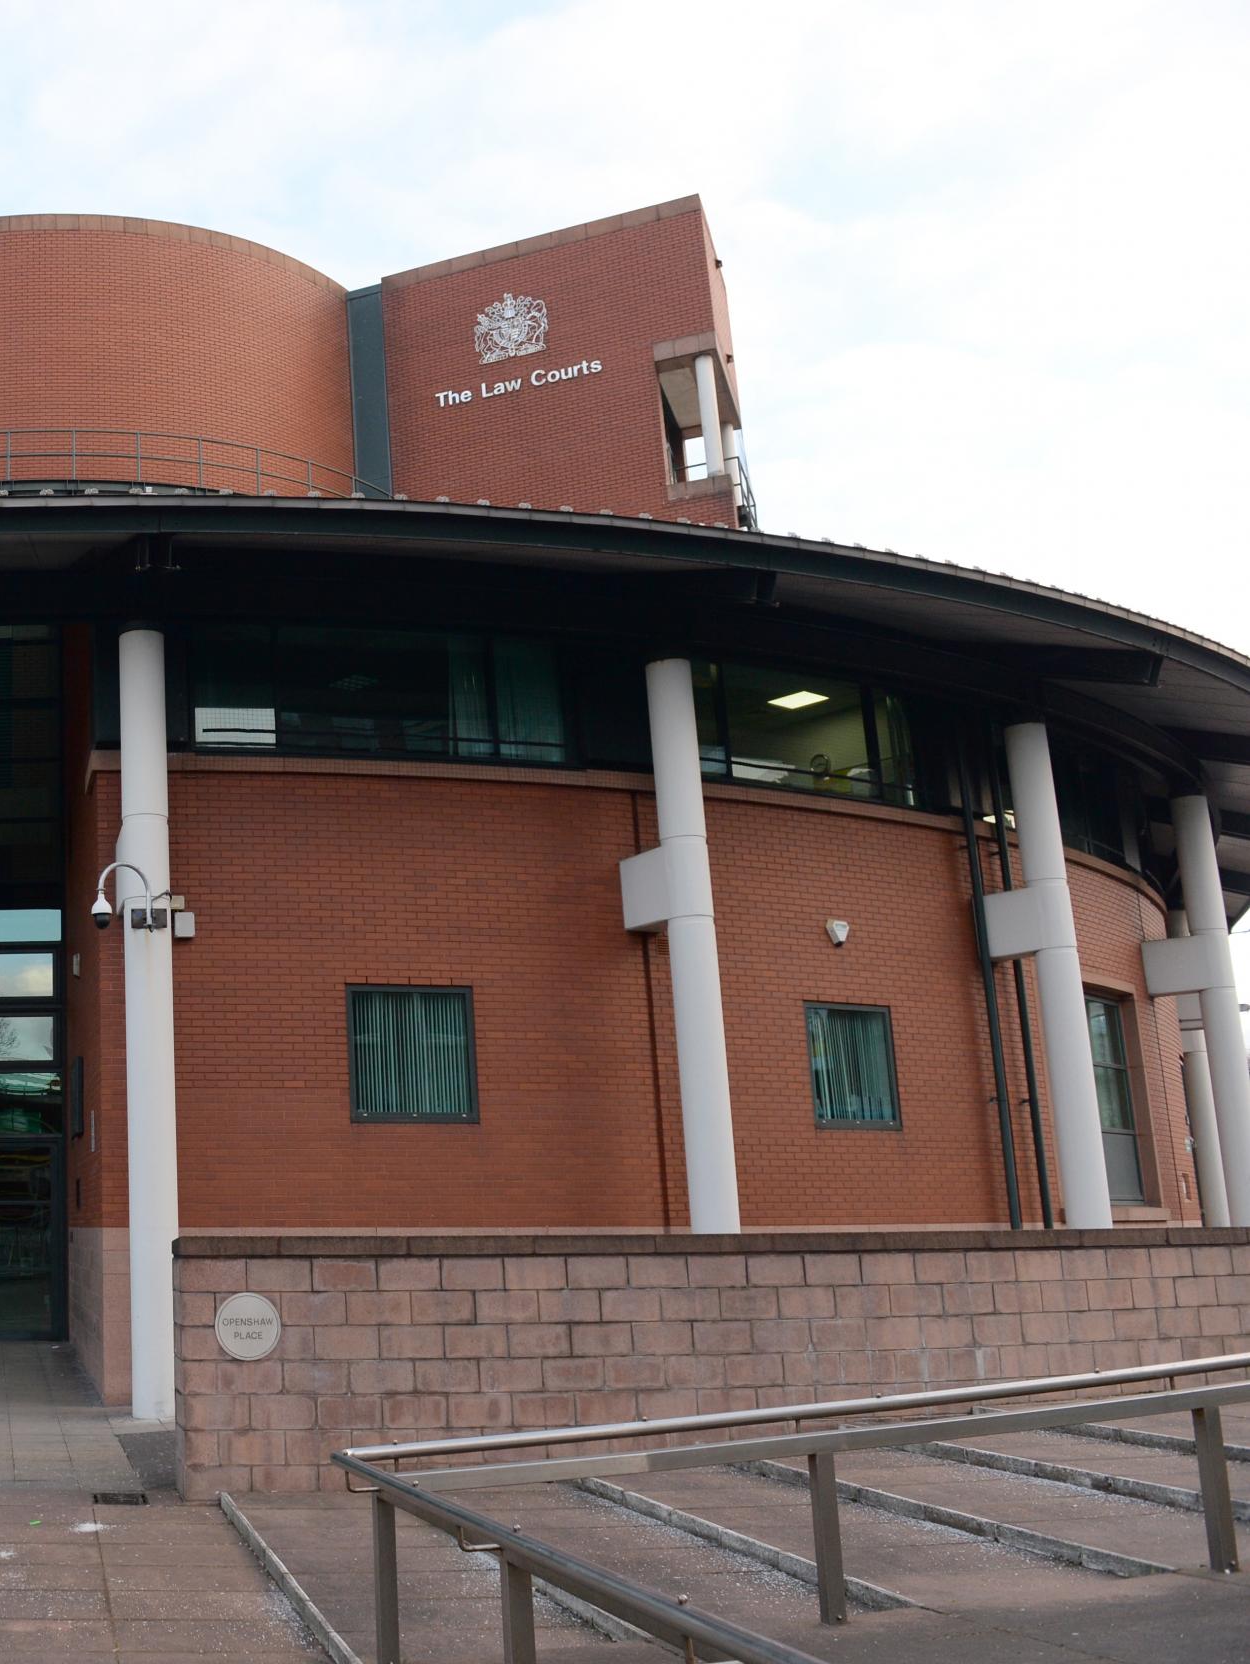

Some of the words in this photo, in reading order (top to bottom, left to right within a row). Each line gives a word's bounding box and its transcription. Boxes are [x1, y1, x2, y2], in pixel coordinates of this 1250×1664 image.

[436, 390, 472, 407] The
[481, 378, 521, 398] Law
[530, 360, 602, 386] Courts
[222, 1318, 273, 1327] OPENSHAW
[234, 1331, 263, 1340] PLACE
